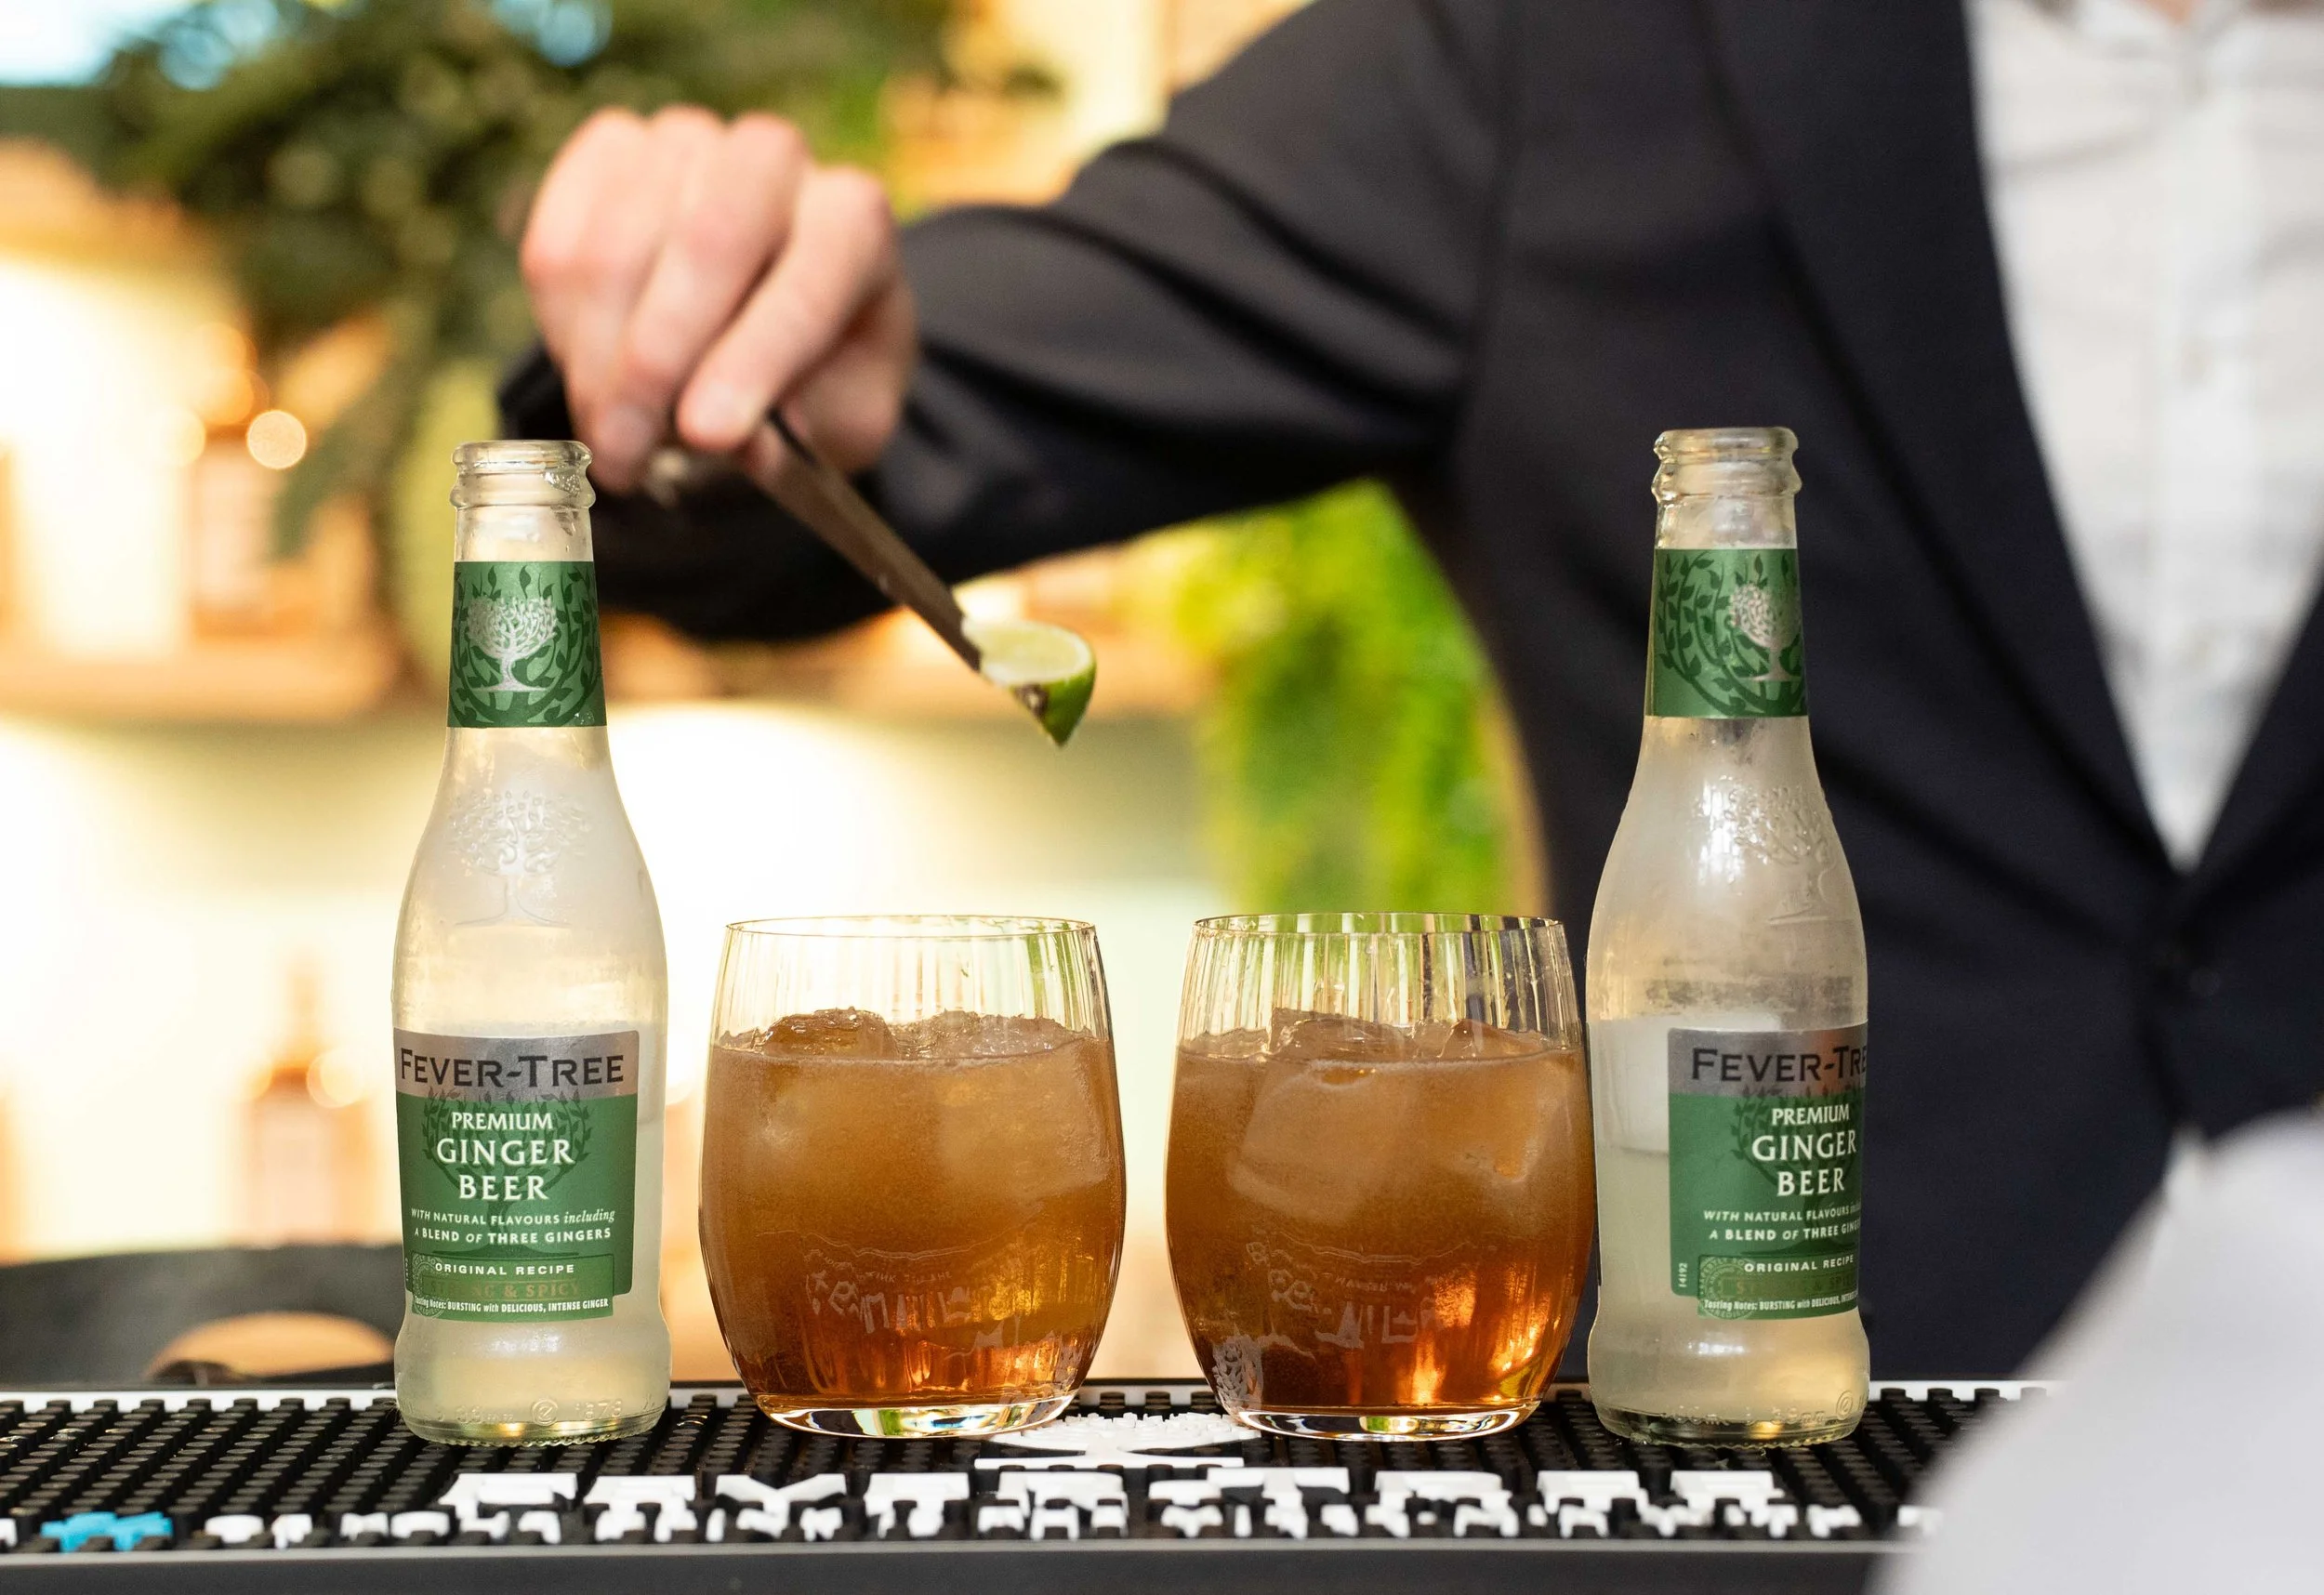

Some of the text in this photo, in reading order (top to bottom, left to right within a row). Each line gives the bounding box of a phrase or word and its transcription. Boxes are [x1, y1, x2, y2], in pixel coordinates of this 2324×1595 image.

[401, 1048, 625, 1088] FEVER-TREE
[452, 1112, 553, 1131] PREMIUM
[1771, 1103, 1850, 1127] PREMIUM
[436, 1137, 575, 1167] GINGER
[1751, 1128, 1857, 1162] GINGER
[458, 1174, 549, 1202] BEER
[1776, 1167, 1845, 1197] BEER
[411, 1208, 615, 1226] WITH NATURAL FLAVOURS including
[1703, 1209, 1740, 1221] WITH
[1744, 1209, 1803, 1222] NATURAL
[1806, 1205, 1850, 1220] FLAVOURS
[414, 1227, 612, 1244] A BLEND OF THREE GINGERS
[1709, 1229, 1719, 1240] A
[1725, 1228, 1776, 1241] BLEND
[1782, 1230, 1800, 1241] OF
[1802, 1224, 1839, 1239] THREE
[435, 1262, 575, 1275] ORIGINAL RECIPE
[1744, 1260, 1818, 1272] ORIGINAL
[1823, 1254, 1854, 1269] RECIPE
[504, 1285, 518, 1298] &
[447, 1300, 482, 1312] BURSTING
[483, 1303, 498, 1312] with
[501, 1303, 546, 1313] DELICIOUS,
[548, 1301, 581, 1312] INTENSE
[583, 1298, 609, 1310] GINGER
[1704, 1298, 1732, 1312] Tasting
[1759, 1300, 1796, 1311] BURSTING
